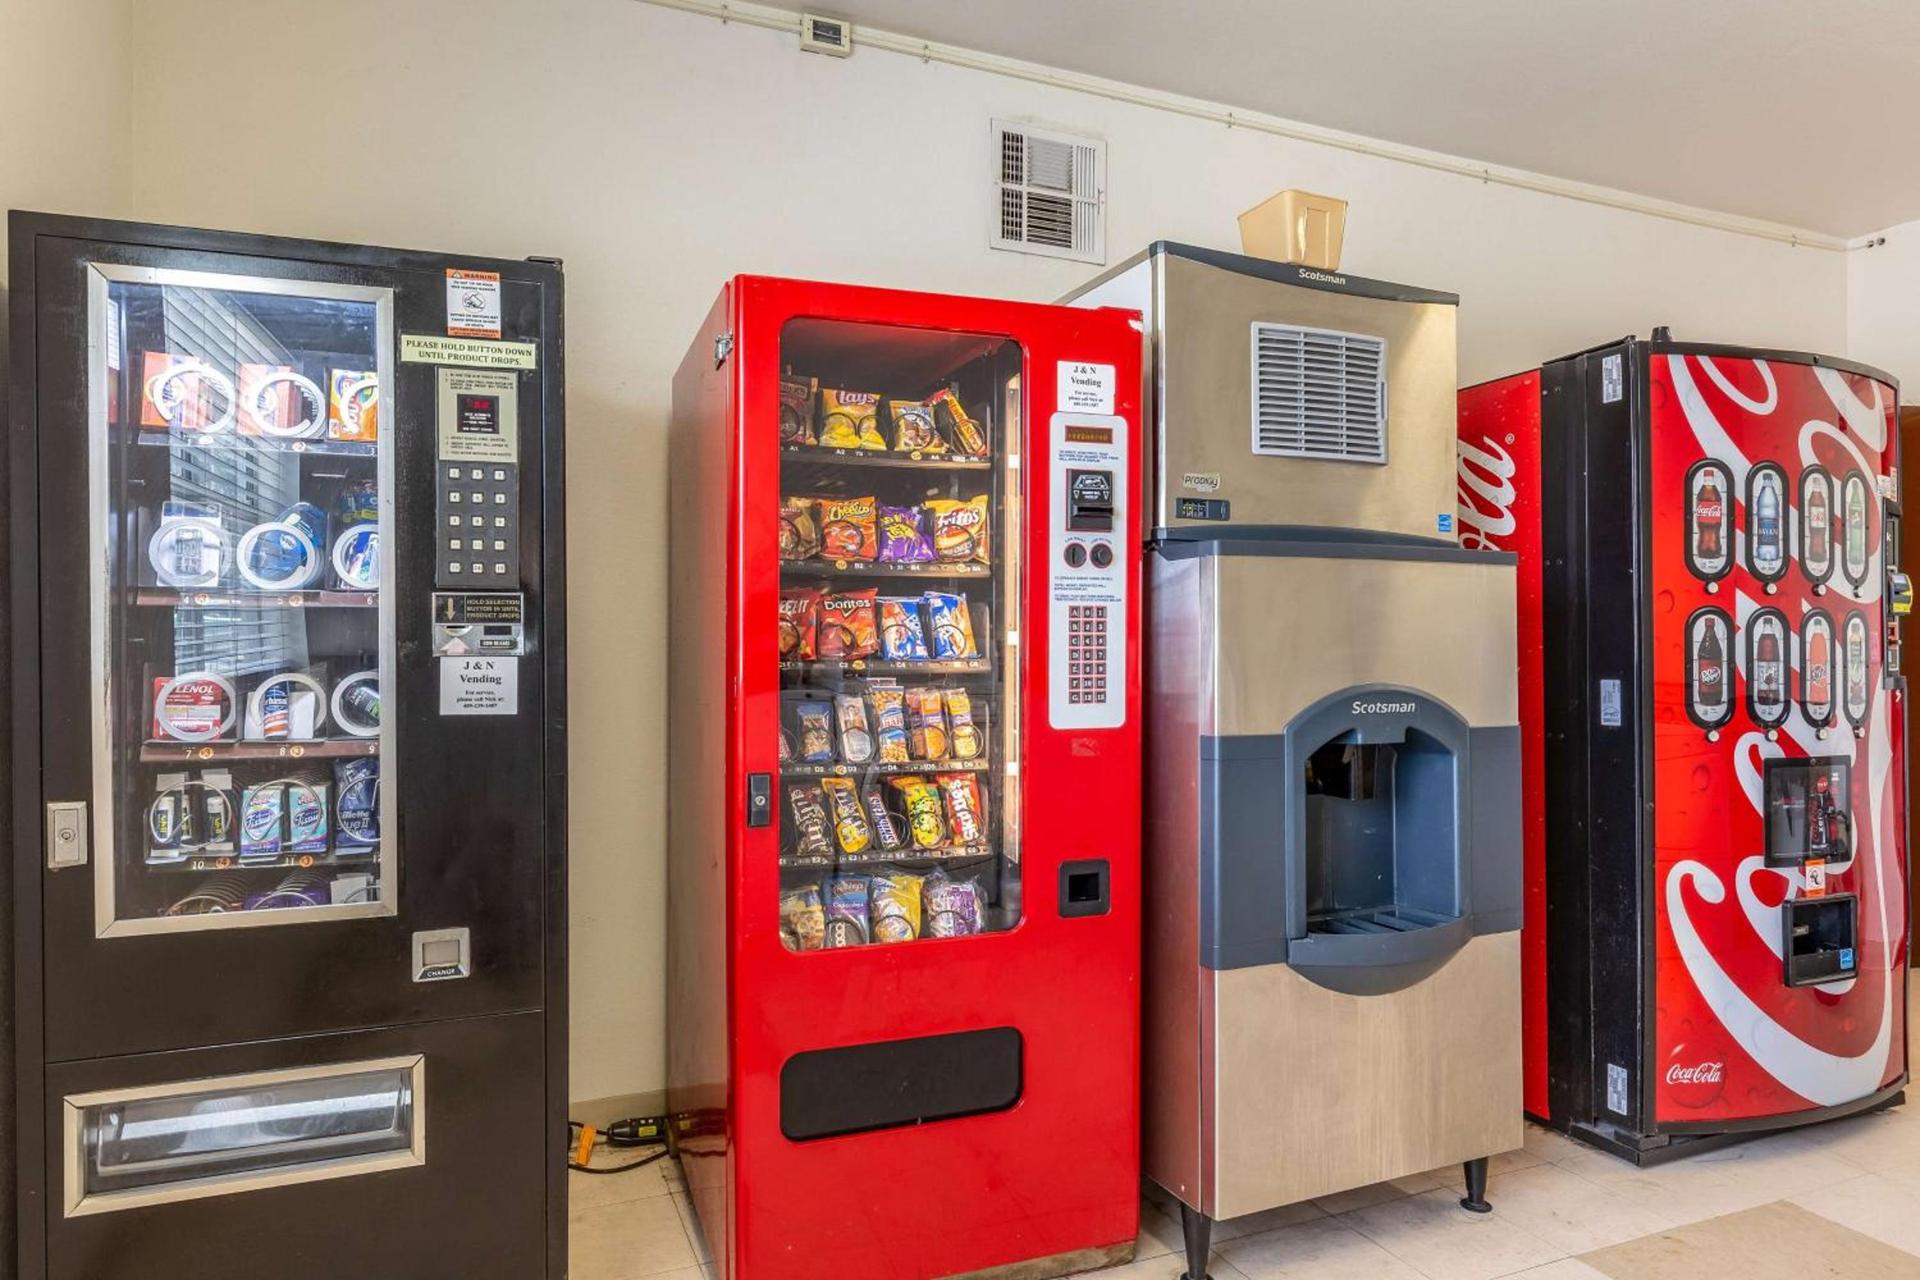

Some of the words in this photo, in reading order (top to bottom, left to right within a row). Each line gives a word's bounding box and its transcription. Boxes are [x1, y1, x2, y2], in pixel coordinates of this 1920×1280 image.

[463, 272, 497, 281] WARNING
[1298, 268, 1346, 286] Scotsman
[406, 340, 438, 349] PLEASE
[440, 343, 466, 352] HOLD
[466, 344, 503, 354] BUTTON
[505, 346, 532, 357] DOWN
[418, 350, 446, 360] UNTIL
[447, 353, 489, 363] PRODUCT
[491, 356, 522, 366] DROPS.
[1073, 366, 1079, 374] J
[1080, 366, 1087, 374] &
[1089, 366, 1097, 374] N
[1071, 376, 1102, 388] Vending
[937, 509, 979, 526] Fritos
[823, 600, 871, 610] Doritos
[463, 661, 470, 670] J
[472, 661, 483, 670] &
[485, 661, 495, 670] N
[460, 674, 502, 685] Vending
[160, 682, 215, 694] LENOL
[1351, 700, 1416, 714] Scotsman
[949, 779, 980, 841] Skittles
[192, 860, 205, 870] 10
[427, 968, 456, 978] CHANGE
[1666, 1061, 1724, 1085] Coca-Cola
